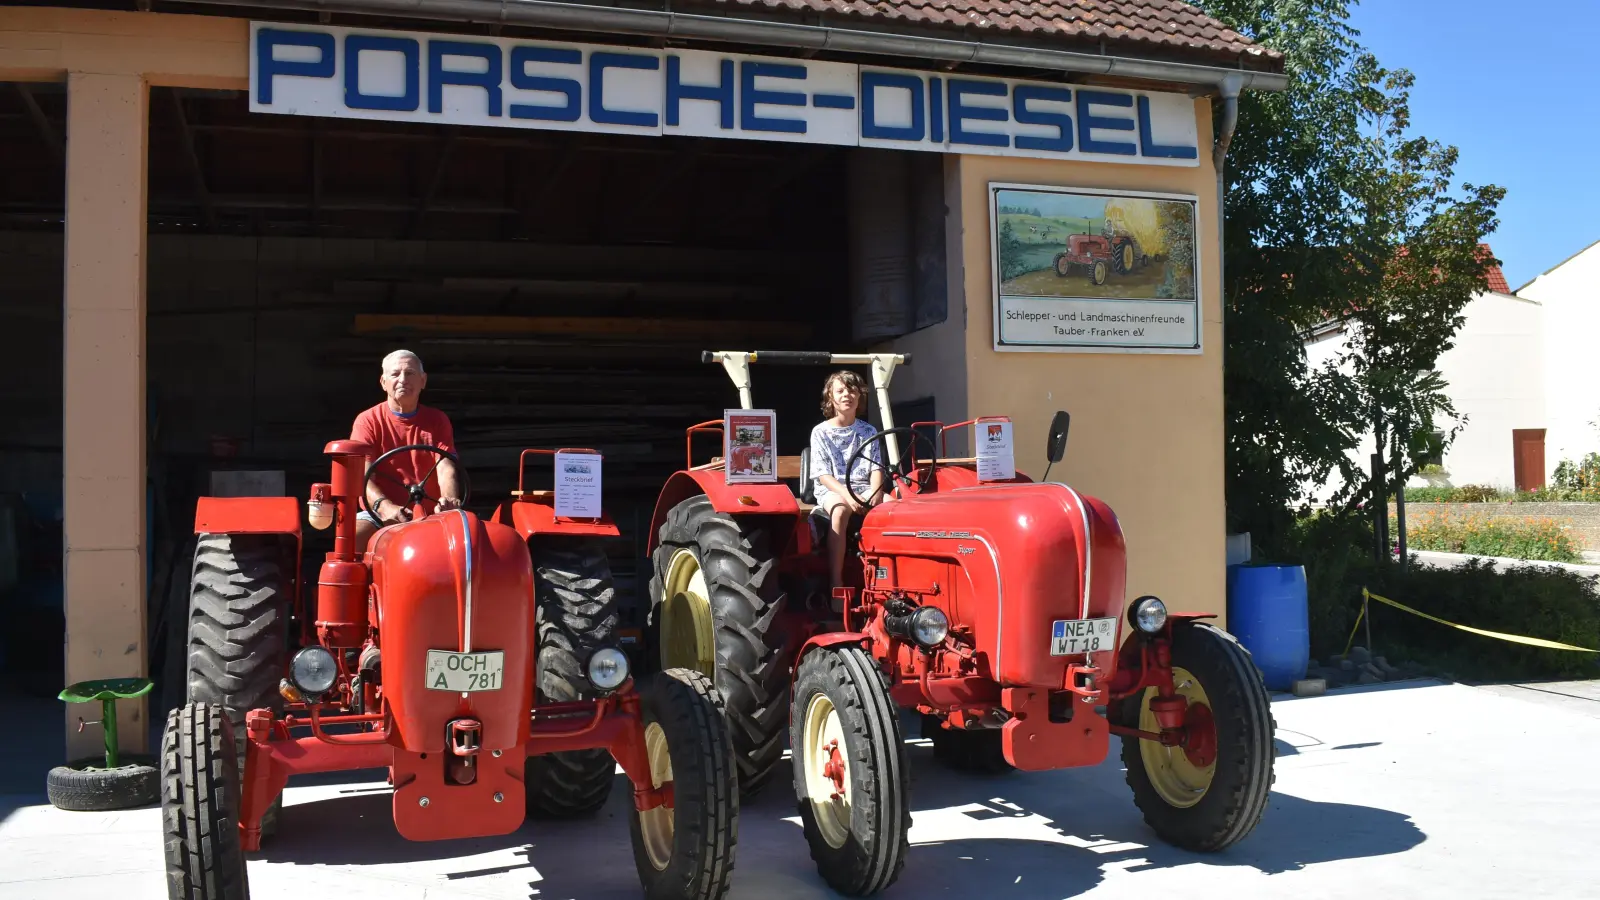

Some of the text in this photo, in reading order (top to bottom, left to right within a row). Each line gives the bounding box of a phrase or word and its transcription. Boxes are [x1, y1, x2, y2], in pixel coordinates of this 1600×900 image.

[256, 28, 1199, 160] PORSCHE-DIESEL
[1058, 312, 1077, 322] und
[1080, 312, 1185, 324] Landmaschinenfreunde
[1066, 622, 1094, 637] NEA
[1059, 637, 1099, 653] WT 18
[447, 654, 486, 671] OCH
[433, 671, 496, 690] A 781
